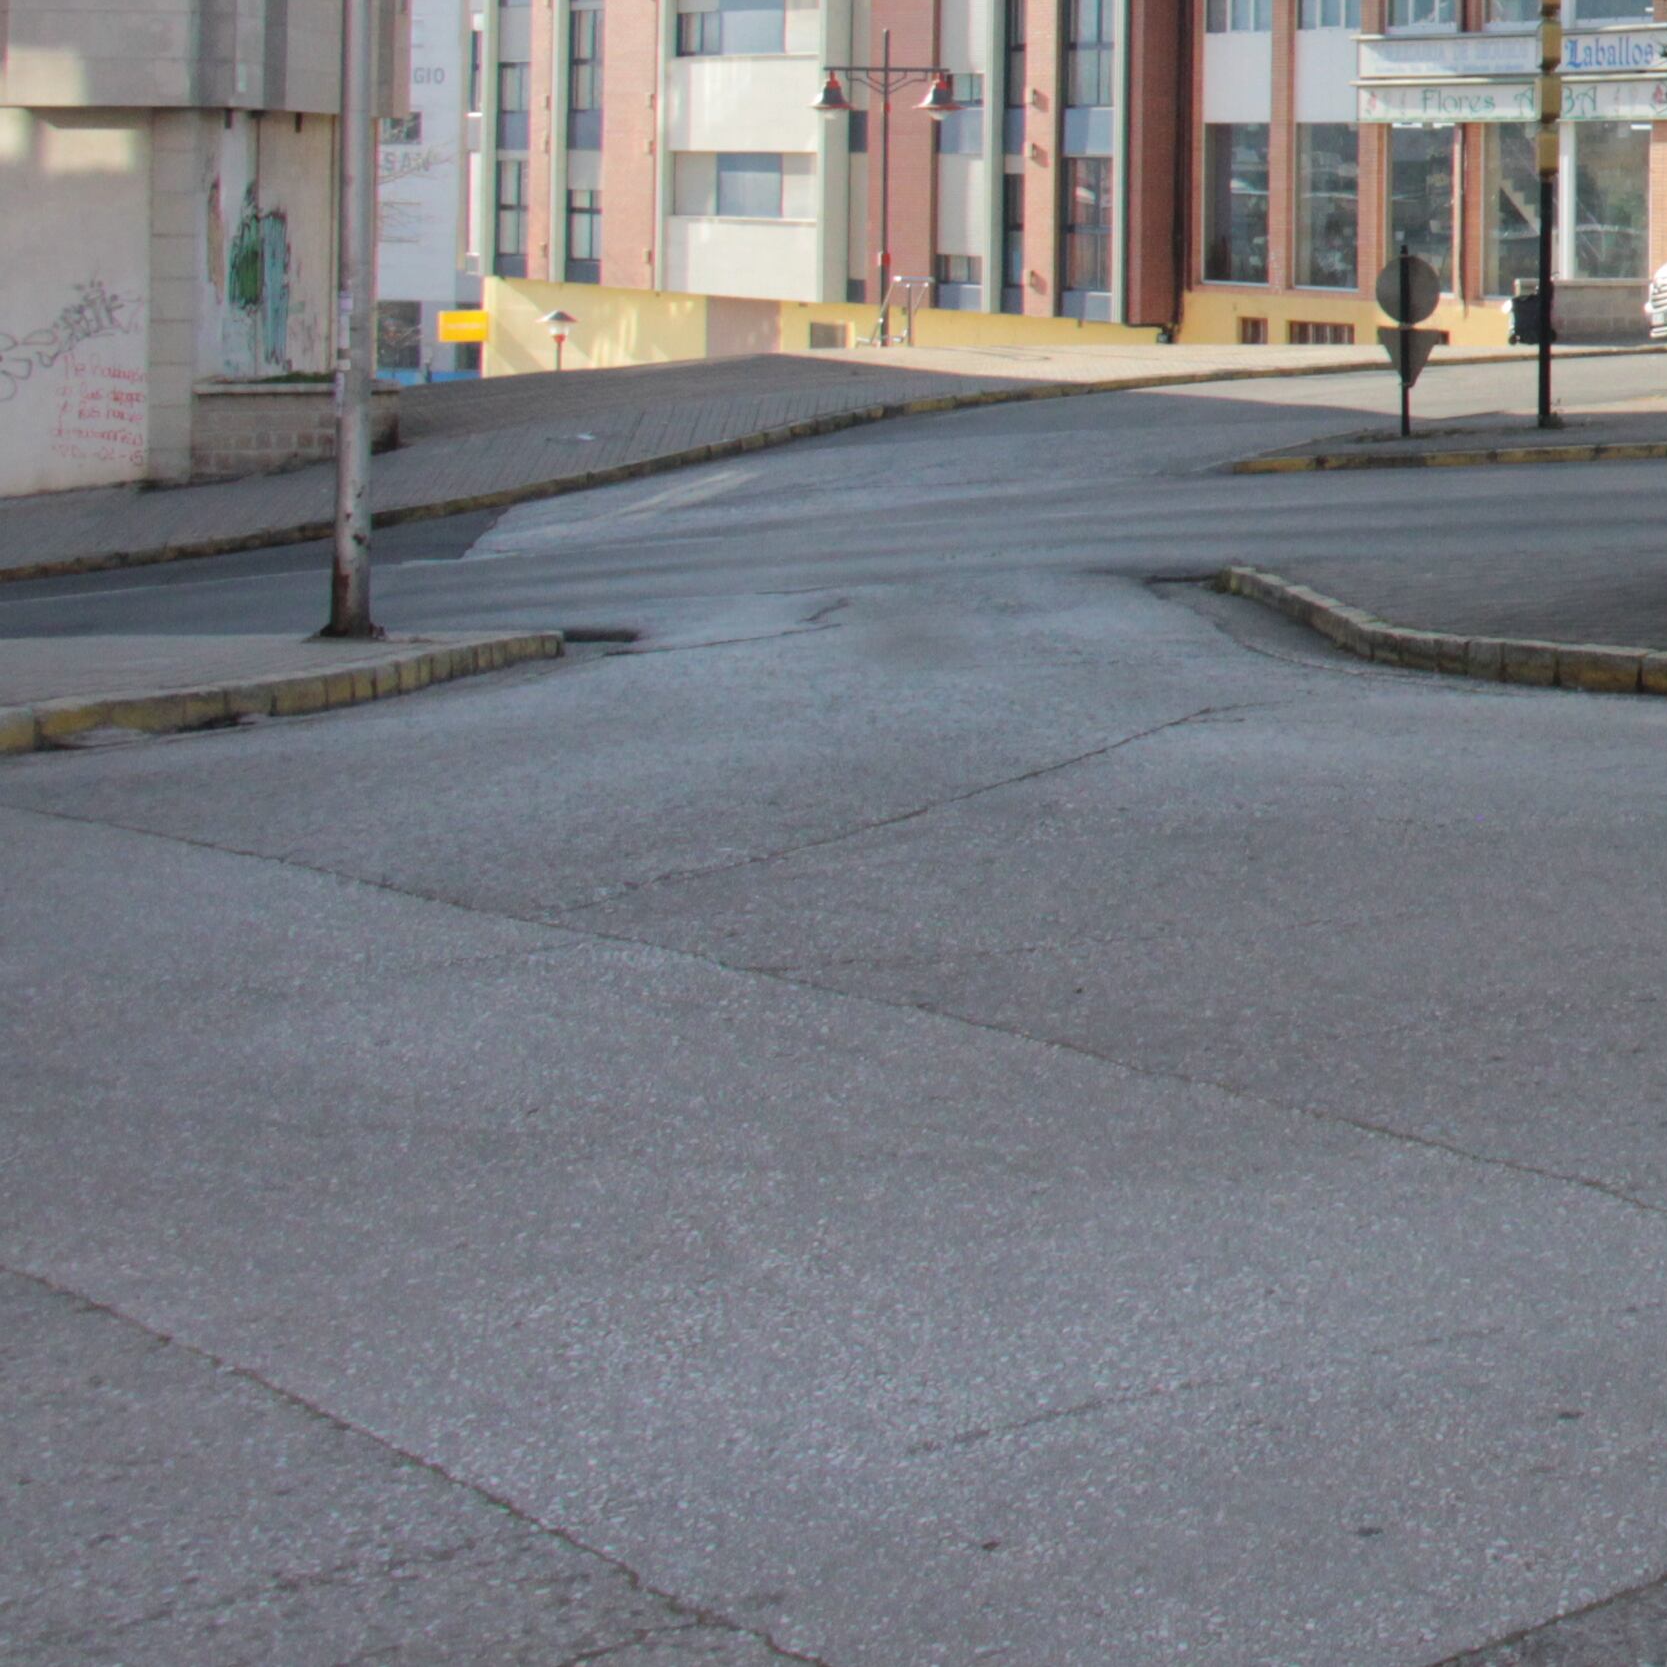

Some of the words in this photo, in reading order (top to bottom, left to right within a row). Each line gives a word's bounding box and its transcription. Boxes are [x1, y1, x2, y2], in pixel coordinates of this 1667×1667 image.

[413, 66, 446, 85] GIO
[1421, 86, 1496, 113] Flores
[1513, 85, 1598, 114] ABA
